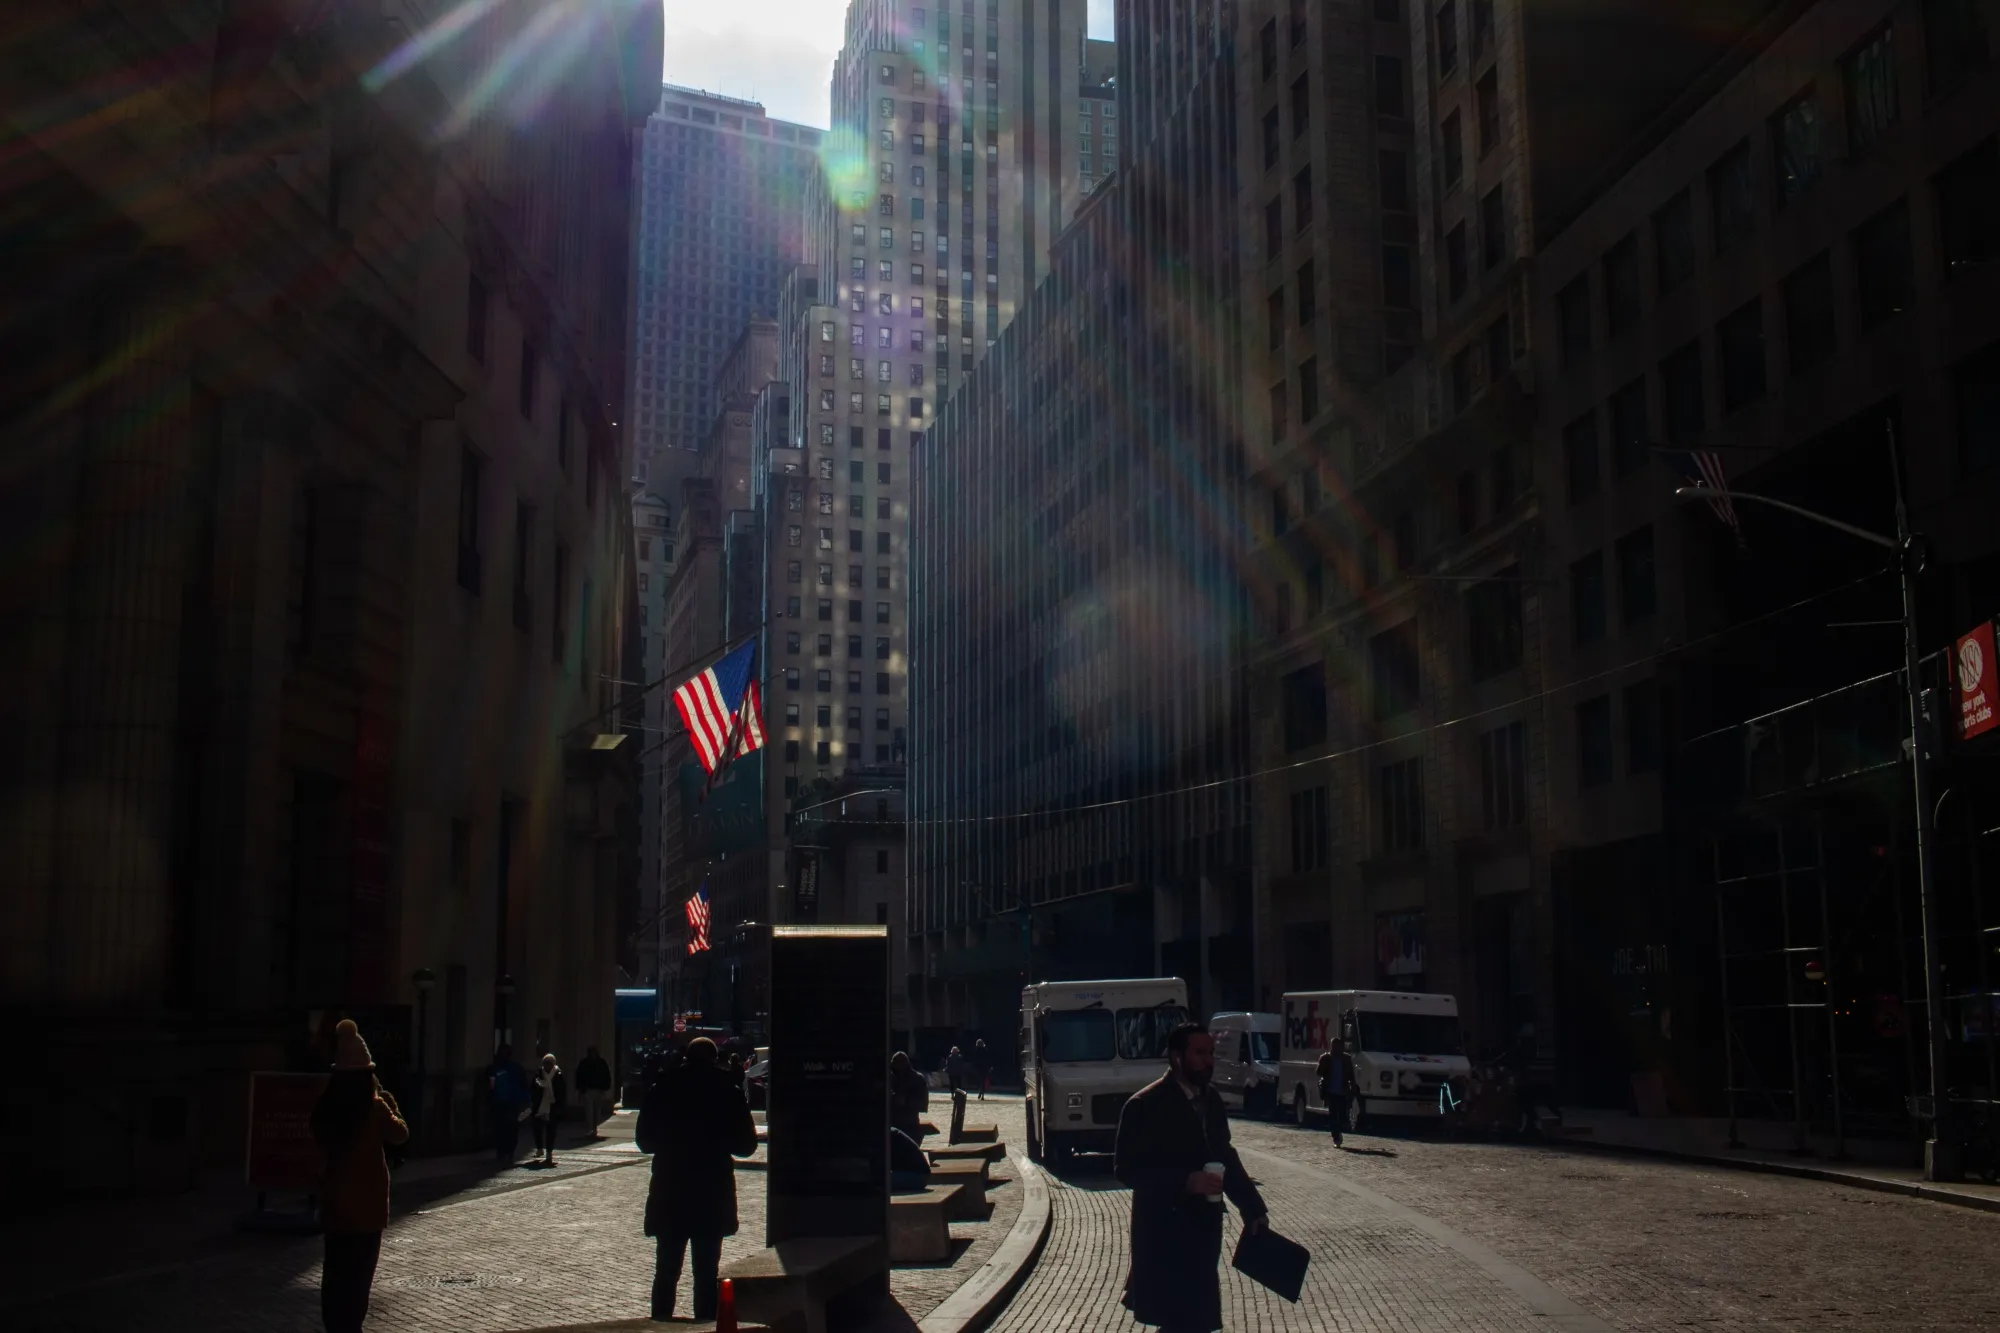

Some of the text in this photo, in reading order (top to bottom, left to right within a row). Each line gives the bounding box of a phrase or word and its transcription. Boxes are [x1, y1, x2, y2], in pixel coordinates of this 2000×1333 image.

[1972, 690, 1986, 711] york
[1976, 706, 1992, 724] clubs
[1612, 947, 1634, 976] JOE
[1285, 1001, 1331, 1050] FedEx
[832, 1061, 854, 1071] NYC
